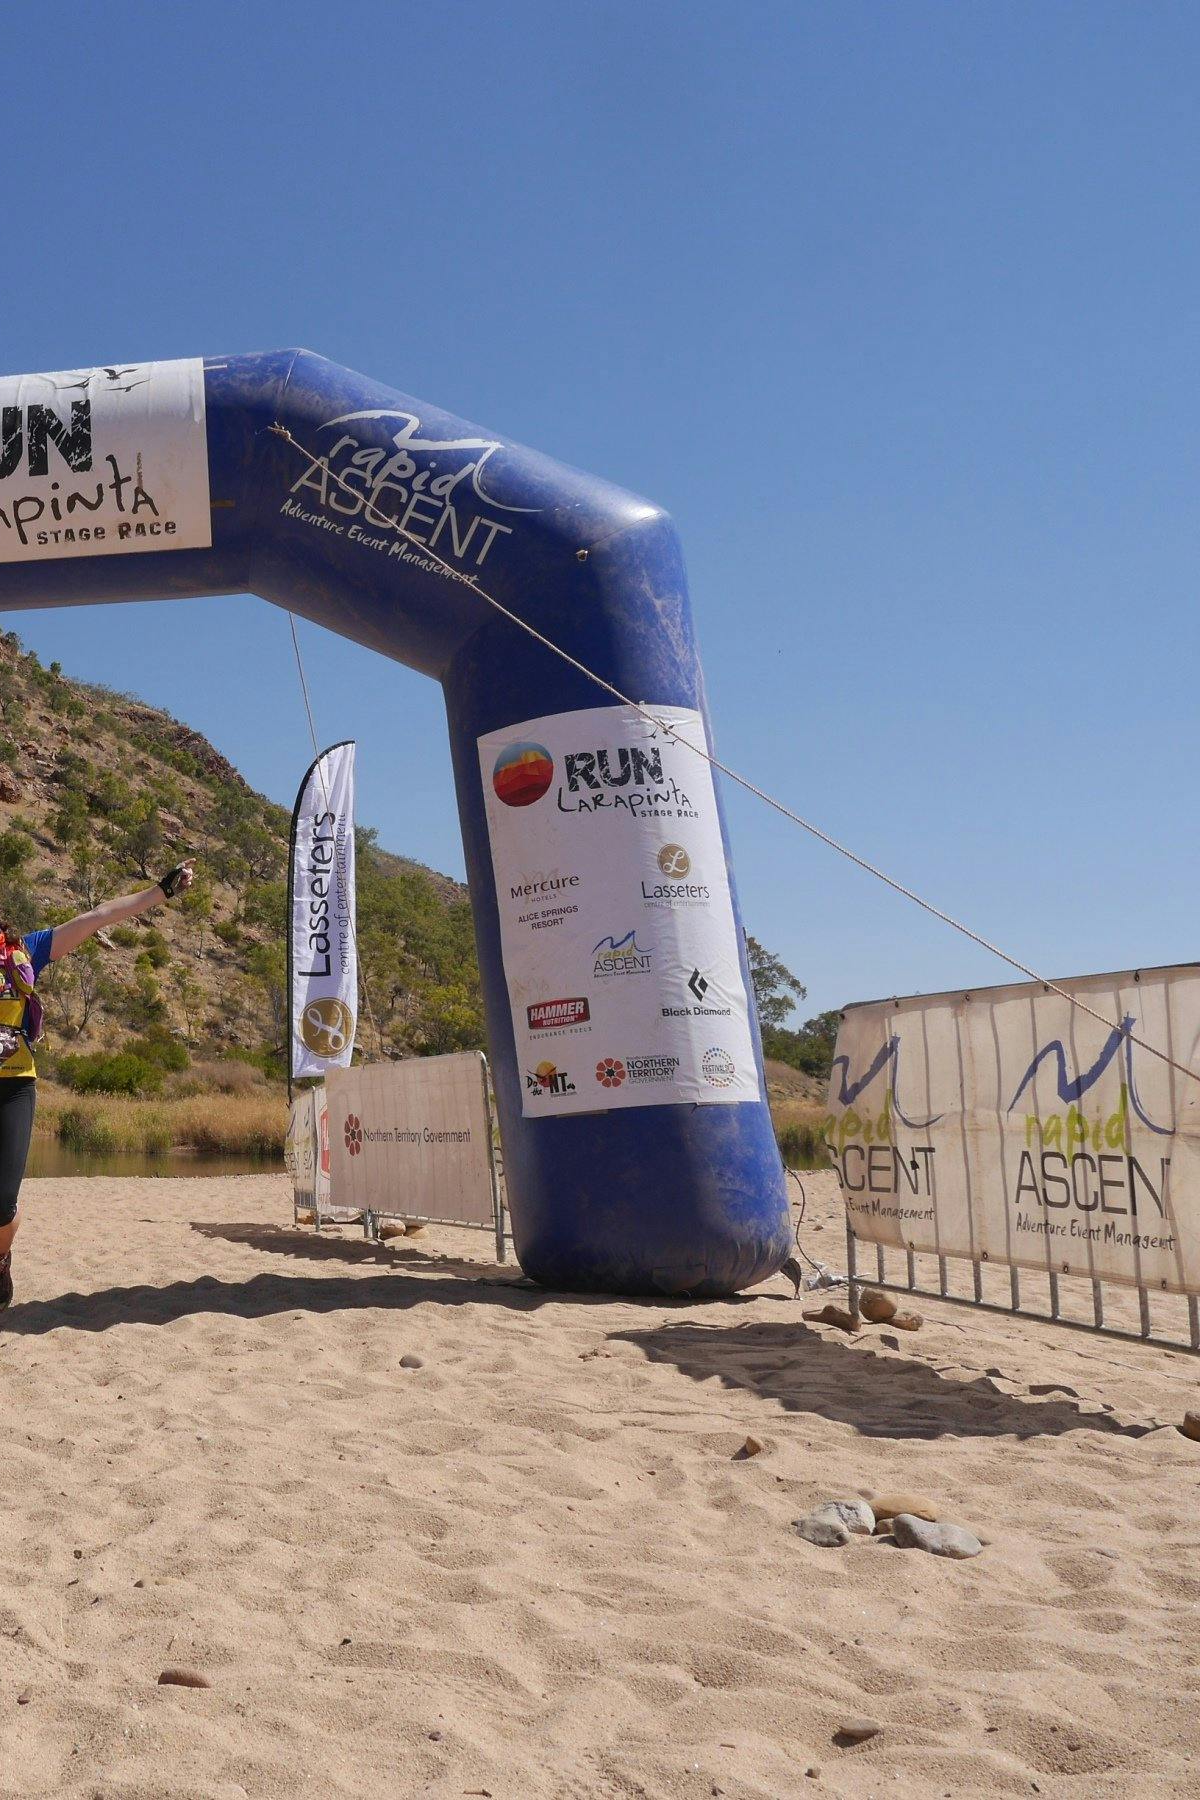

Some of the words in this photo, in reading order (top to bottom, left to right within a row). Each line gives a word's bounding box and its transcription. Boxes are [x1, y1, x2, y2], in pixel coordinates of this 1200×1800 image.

[329, 435, 476, 505] rapid
[290, 455, 512, 566] ASCENT
[280, 498, 344, 535] Adventure
[347, 524, 389, 551] Event
[388, 541, 480, 587] Management
[564, 747, 664, 793] RUN
[298, 811, 335, 977] Lasseters
[510, 875, 580, 899] Mercure
[641, 881, 709, 898] Lasseters
[334, 912, 349, 931] of
[518, 912, 540, 923] ALICE
[541, 905, 579, 918] SPRINGS
[531, 917, 564, 930] RESORT
[336, 935, 350, 976] centre
[597, 943, 634, 960] rapid
[593, 955, 652, 973] ASCENT
[530, 1001, 584, 1022] HAMMER
[542, 1015, 577, 1026] NUTRITION
[662, 1007, 692, 1017] Black
[693, 1006, 731, 1017] Diamond
[626, 1057, 680, 1069] NORTHERN
[627, 1067, 675, 1078] TERRITORY
[526, 1075, 538, 1089] Do
[549, 1072, 568, 1094] NT
[628, 1076, 674, 1085] GOVERNMENT
[823, 1089, 892, 1155] apid
[1026, 1083, 1132, 1167] rapid
[363, 1128, 392, 1141] Northern
[394, 1127, 421, 1146] Territory
[423, 1127, 471, 1143] Government
[872, 1199, 934, 1220] Management
[1016, 1212, 1067, 1237] Adventure
[1070, 1219, 1102, 1241] Event
